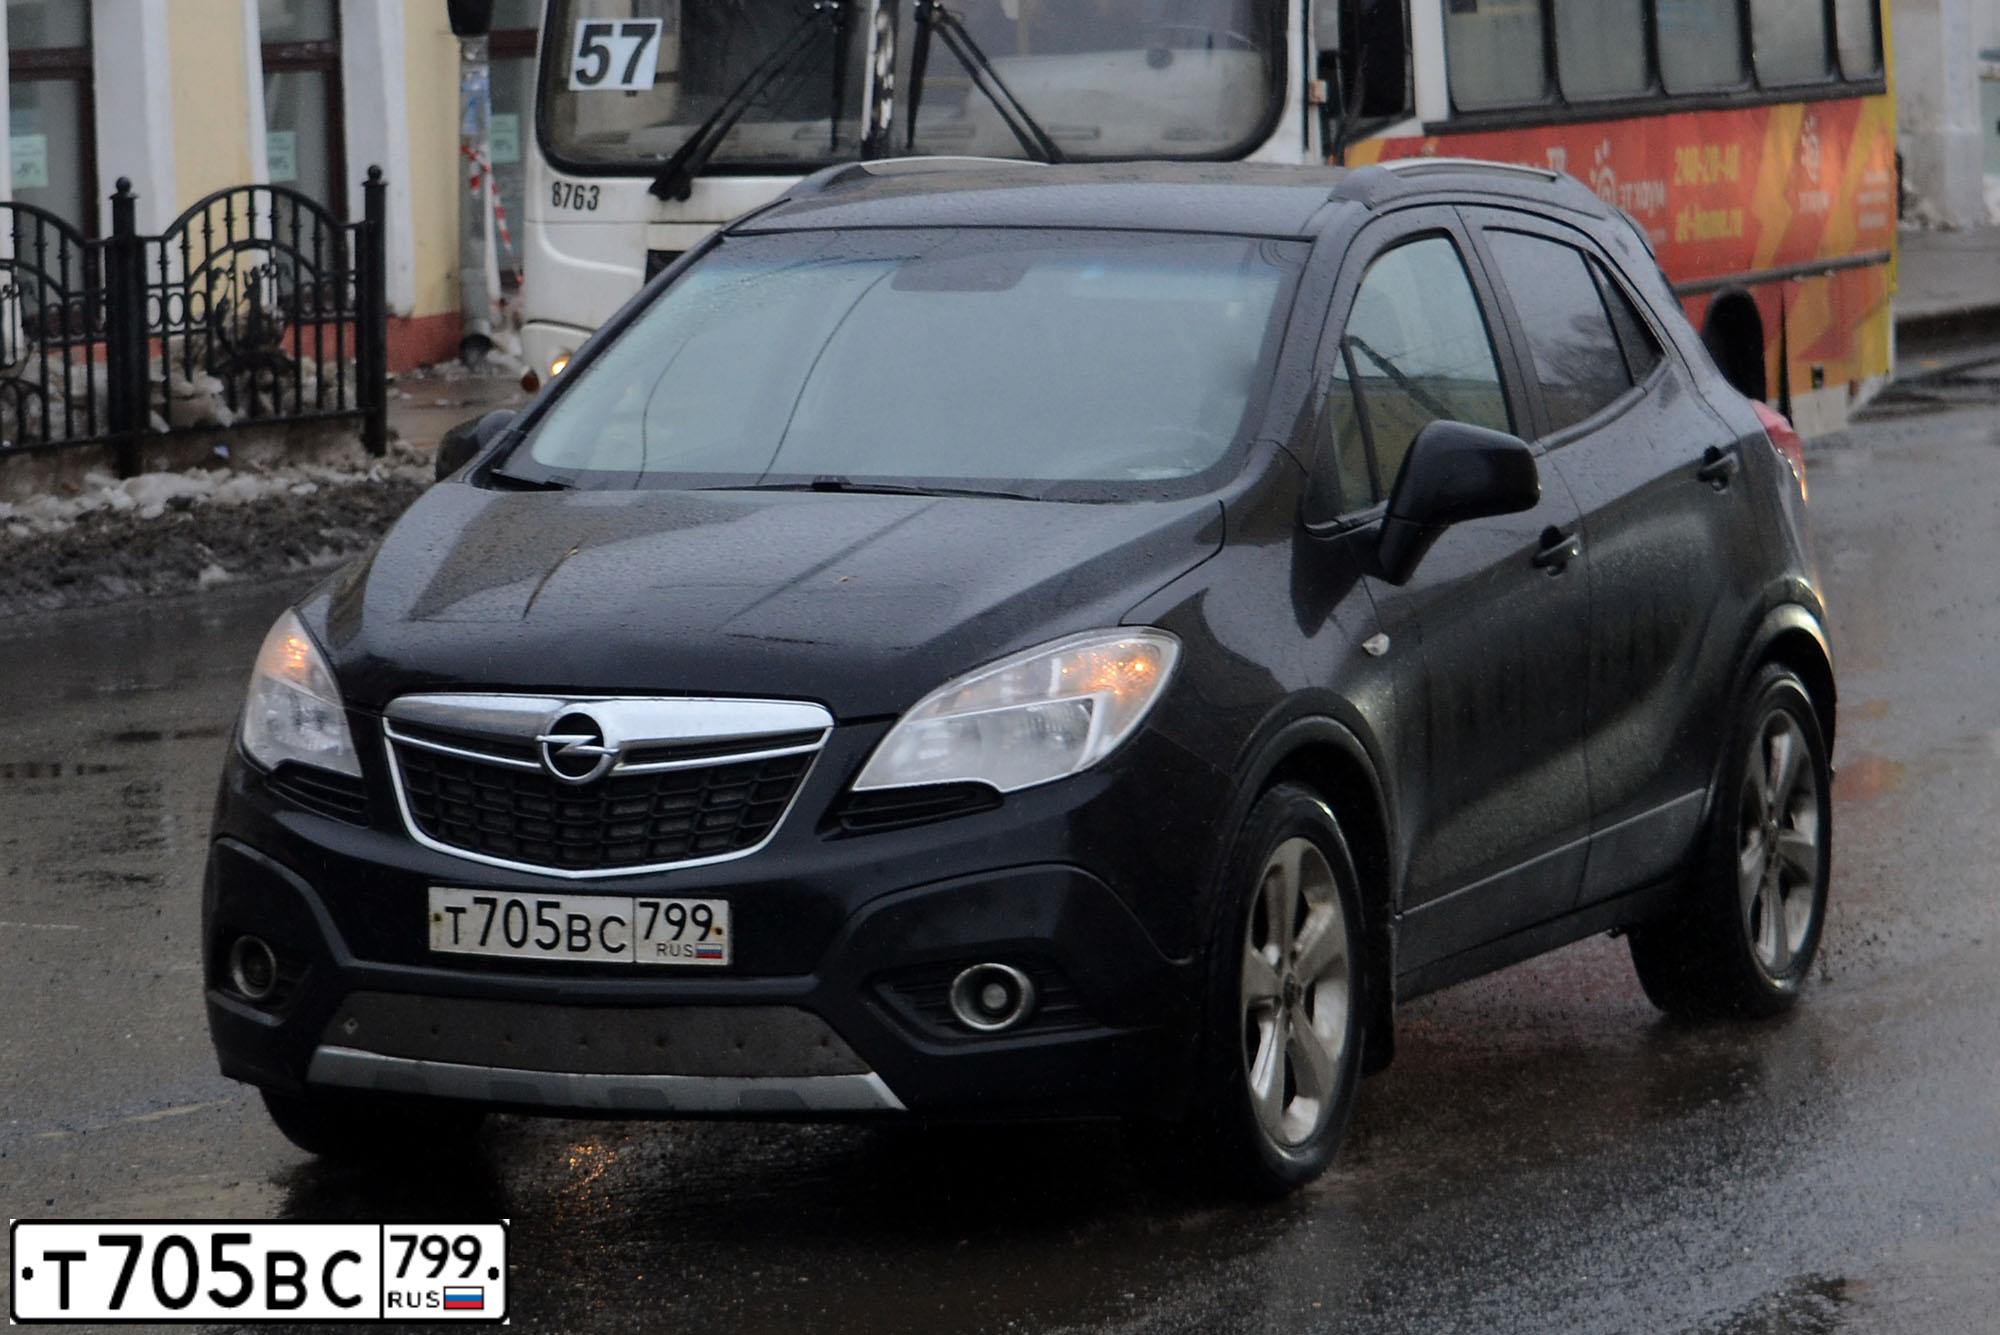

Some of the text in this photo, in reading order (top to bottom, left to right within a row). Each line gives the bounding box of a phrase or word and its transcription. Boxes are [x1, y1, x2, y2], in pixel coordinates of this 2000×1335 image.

[575, 24, 657, 86] 57
[552, 181, 600, 211] 8763
[638, 901, 713, 942] 799
[656, 943, 693, 957] RUS
